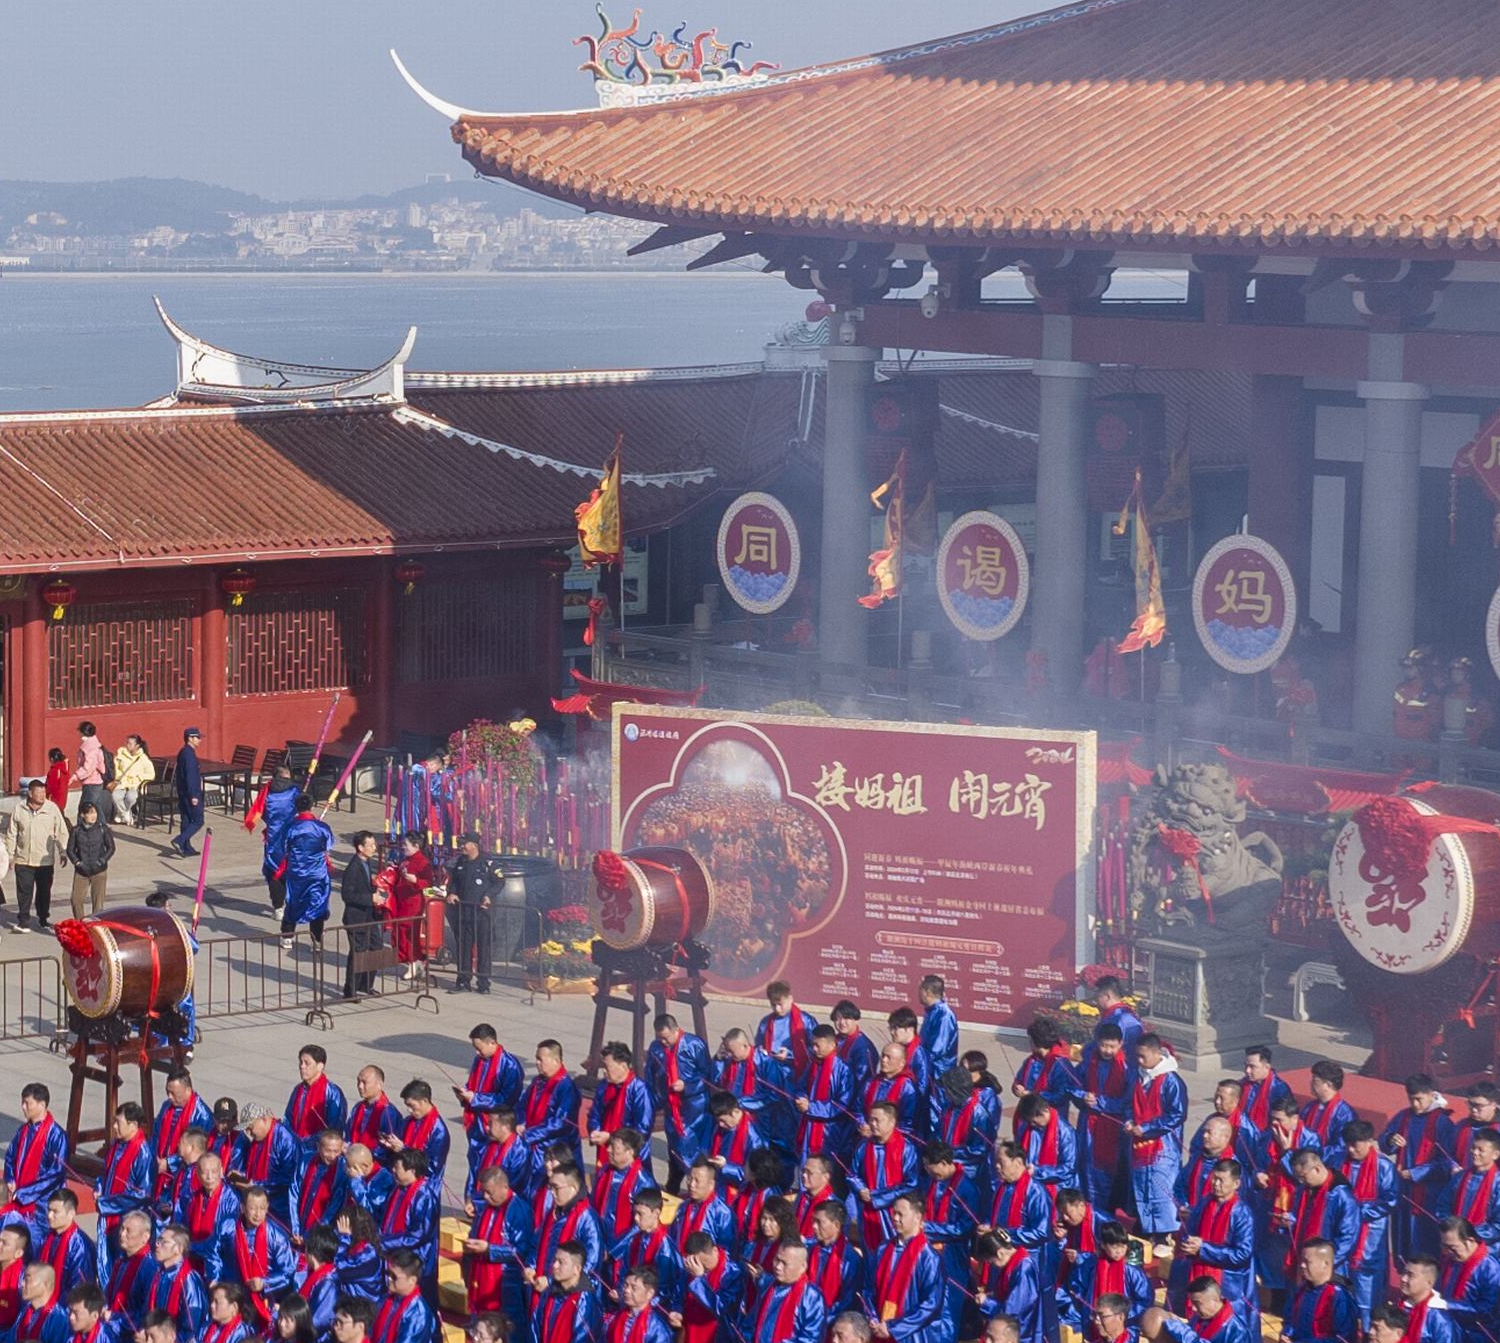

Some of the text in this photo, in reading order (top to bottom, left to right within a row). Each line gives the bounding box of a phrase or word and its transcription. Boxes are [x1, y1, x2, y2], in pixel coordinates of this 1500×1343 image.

[736, 524, 777, 568] 同
[958, 547, 1005, 596] 谒
[1215, 569, 1273, 624] 妈
[811, 760, 1052, 831] 接妈祖 闹元宵
